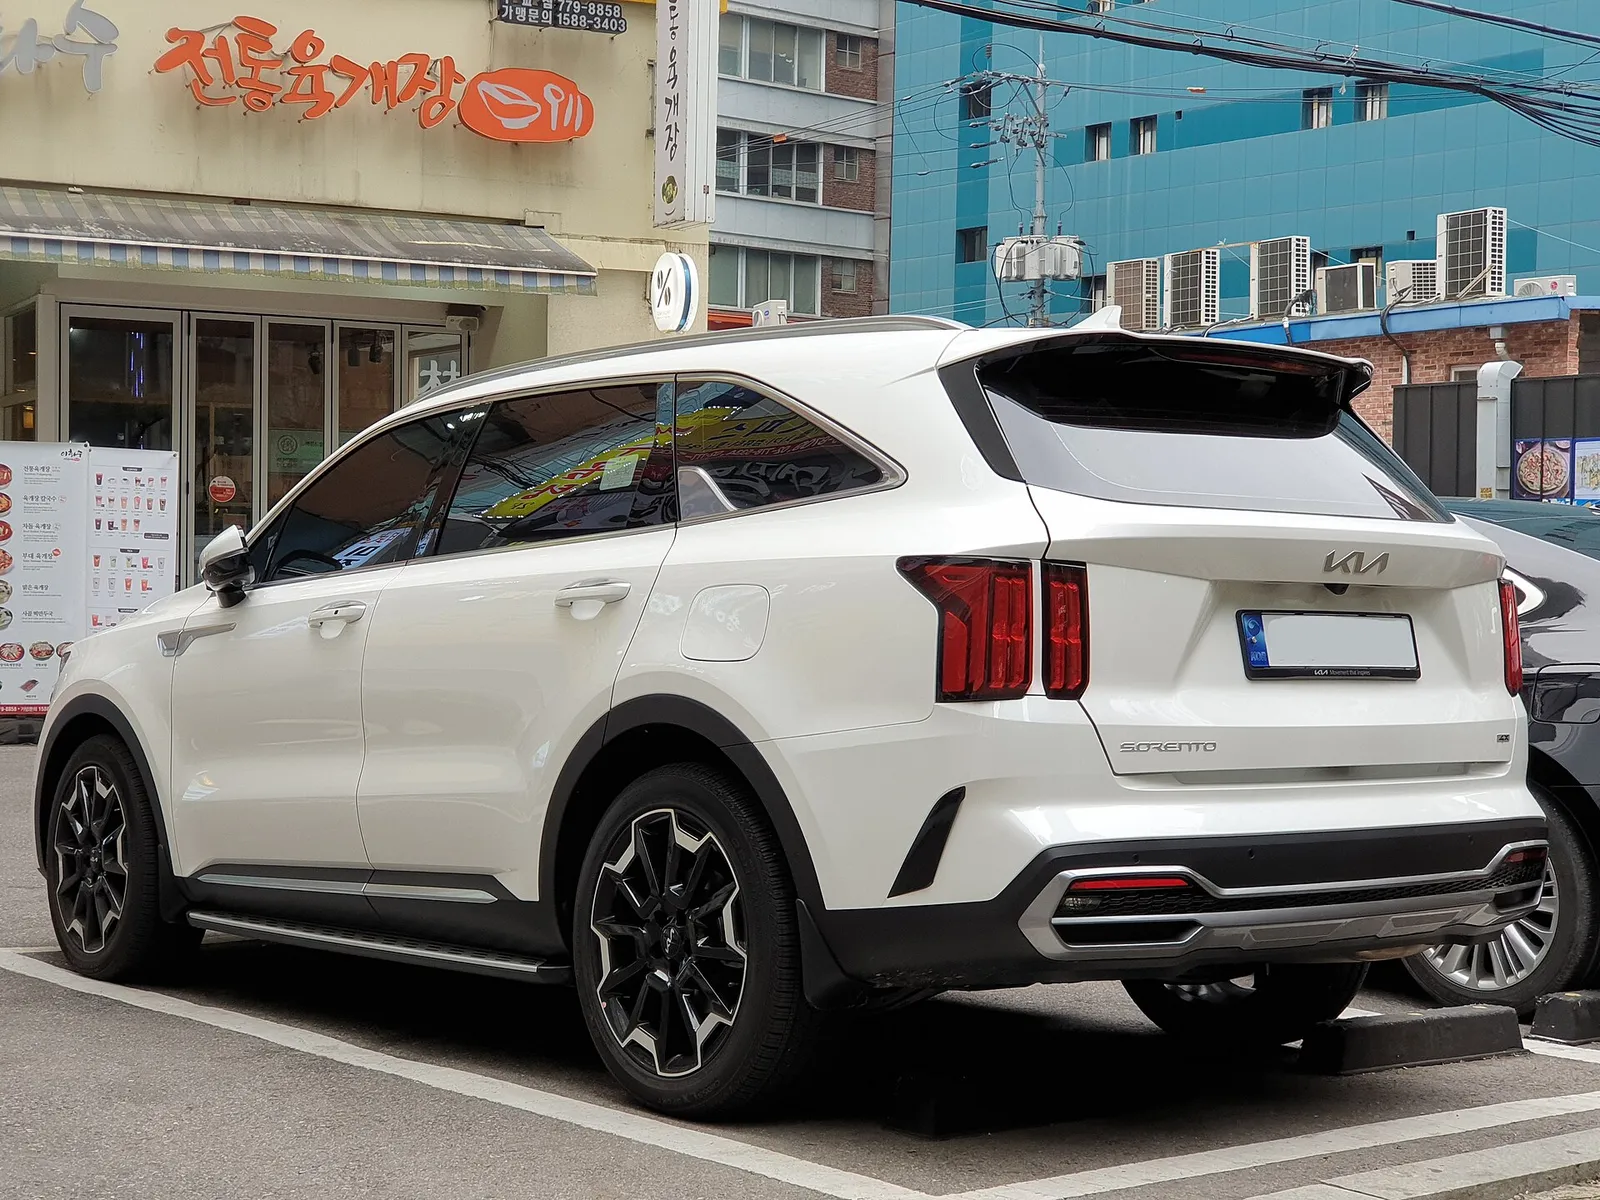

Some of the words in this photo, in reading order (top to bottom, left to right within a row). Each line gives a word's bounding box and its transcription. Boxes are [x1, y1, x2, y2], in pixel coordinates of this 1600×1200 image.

[502, 5, 552, 25] 가맹문의
[557, 13, 626, 32] 1588-3403
[153, 15, 467, 129] 전통육개장
[1323, 549, 1390, 576] KIA
[1119, 741, 1217, 753] SORENTO
